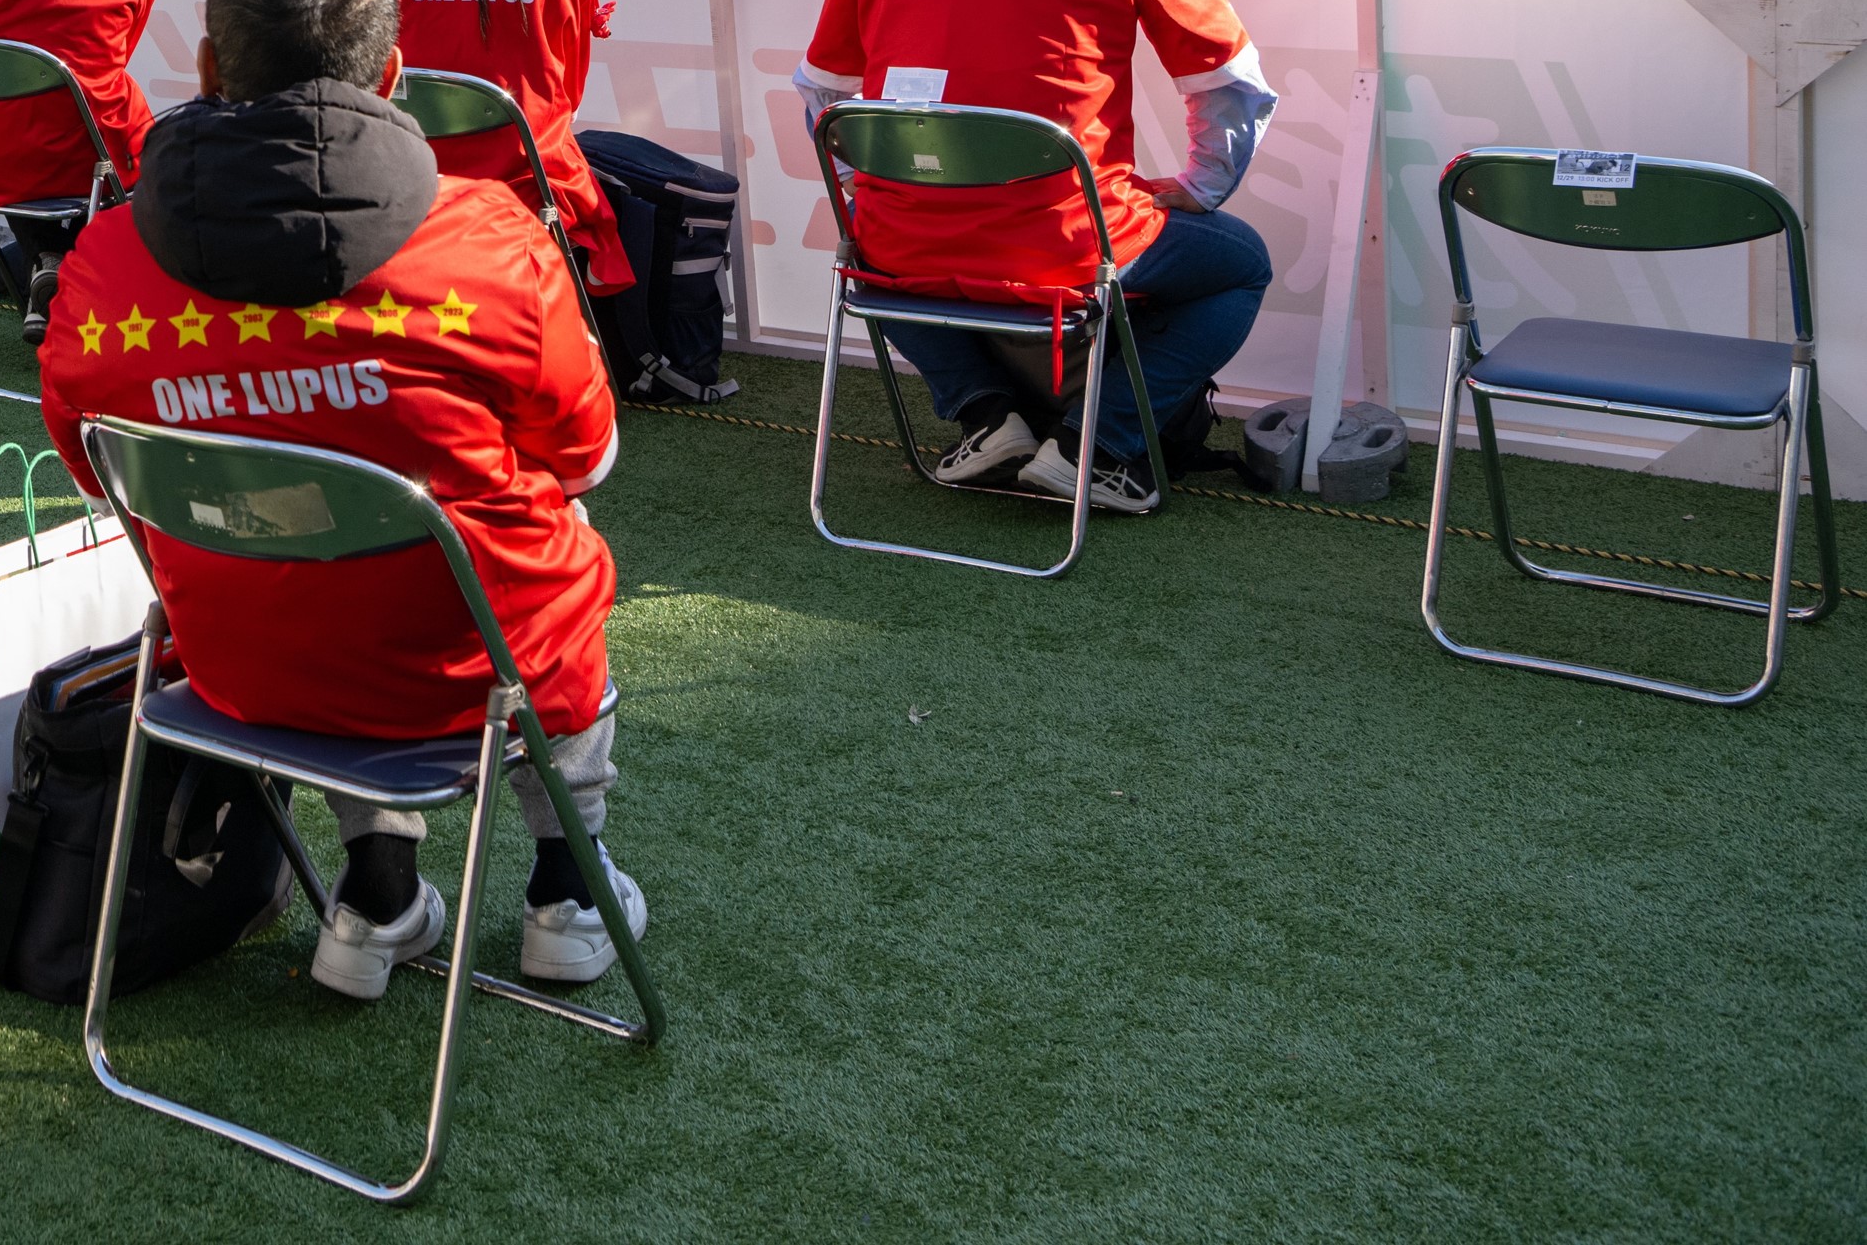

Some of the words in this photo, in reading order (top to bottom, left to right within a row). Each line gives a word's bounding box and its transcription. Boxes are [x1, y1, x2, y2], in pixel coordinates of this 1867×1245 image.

[1619, 163, 1631, 172] 12
[182, 317, 200, 328] 1998
[242, 313, 264, 323] 2003
[377, 307, 398, 319] 2006
[443, 307, 464, 317] 2023
[151, 372, 237, 424] ONE
[237, 358, 390, 416] LUPUS
